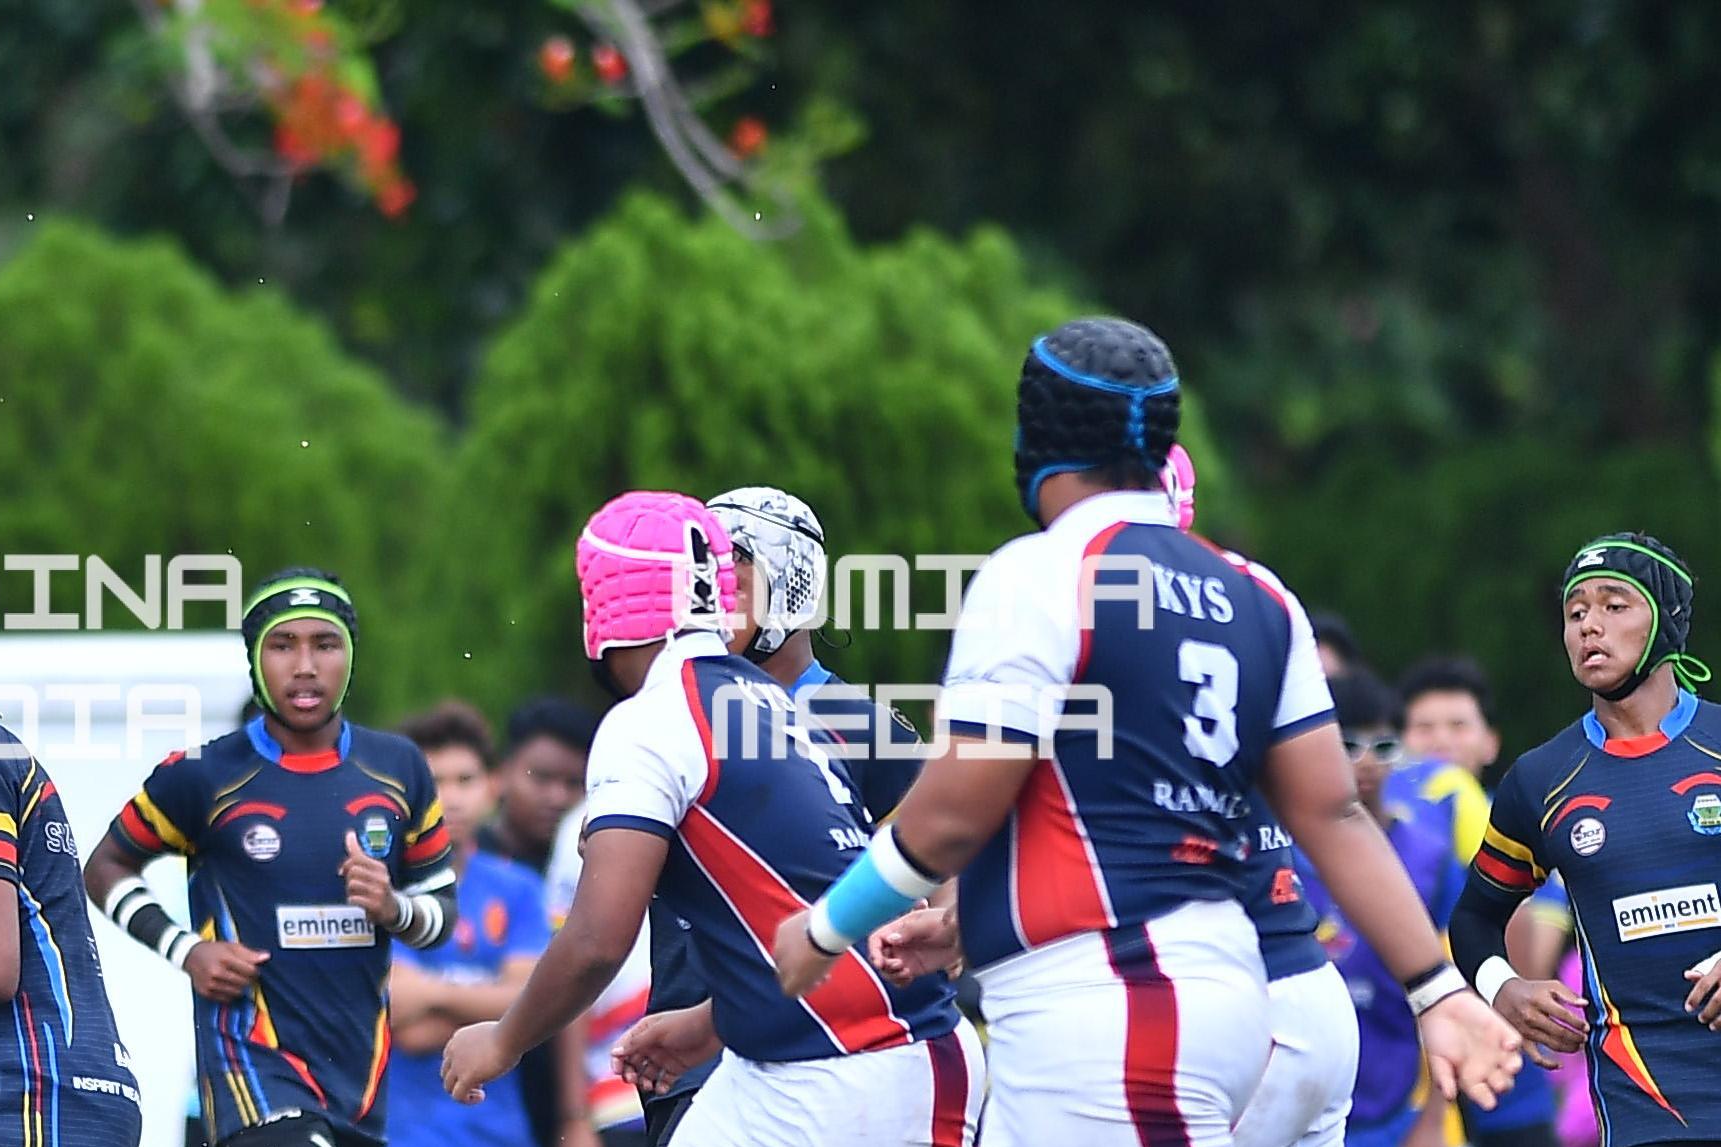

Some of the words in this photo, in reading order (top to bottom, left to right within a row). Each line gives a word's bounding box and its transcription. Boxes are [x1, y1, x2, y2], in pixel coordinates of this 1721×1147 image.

[1151, 563, 1234, 624] KYS
[1178, 638, 1240, 768] 3
[1619, 893, 1718, 927] eminent
